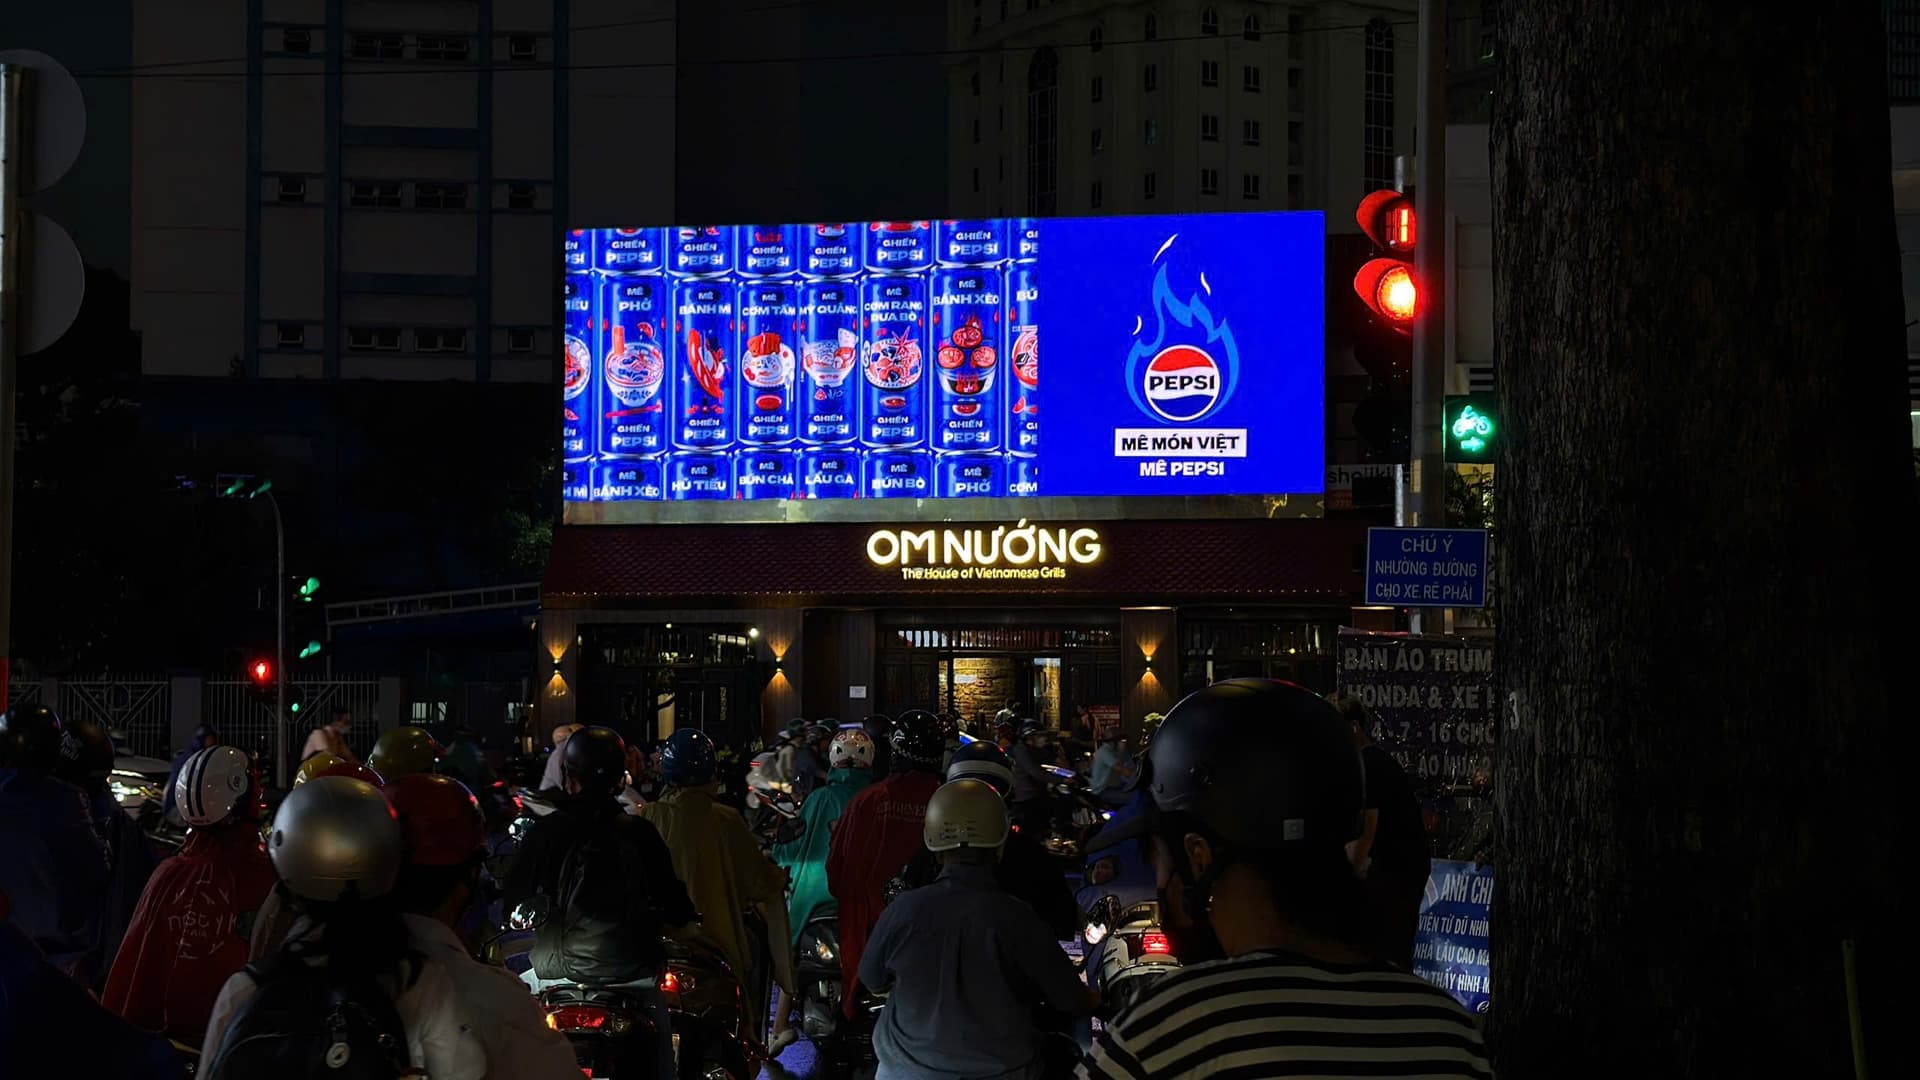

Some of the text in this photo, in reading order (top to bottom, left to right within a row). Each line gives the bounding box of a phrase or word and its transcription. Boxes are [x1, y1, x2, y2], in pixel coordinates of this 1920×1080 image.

[877, 249, 924, 261] PEPSI
[950, 242, 998, 256] PEPSI
[606, 252, 653, 264] PEPSI
[678, 254, 724, 266] PEPSI
[747, 256, 790, 268] PEPSI
[809, 257, 853, 269] PEPSI
[891, 301, 923, 310] RANG
[1149, 375, 1215, 391] PEPSI
[684, 428, 726, 440] PEPSI
[748, 424, 789, 436] PEPSI
[808, 423, 849, 435] PEPSI
[872, 425, 915, 437] PEPSI
[611, 435, 657, 448] PEPSI
[943, 430, 990, 443] PEPSI
[1122, 433, 1240, 453] MÊ MÓN VIỆT
[1140, 460, 1224, 476] MÊ PEPSI
[866, 518, 1101, 565] OM NƯỚNG
[1401, 534, 1454, 553] CHÚ Ý
[902, 566, 1066, 580] The House of Vietnamese Grills
[1375, 556, 1478, 577] NHƯỜNG ĐƯỜNG
[1375, 580, 1473, 601] CHO XE RẼ PHẢI
[1394, 642, 1425, 672] ÁO
[1346, 683, 1422, 708] HONDA
[1428, 686, 1443, 708] &
[1428, 720, 1451, 744] 16
[1440, 873, 1469, 904] ANH
[1456, 946, 1476, 965] CAO
